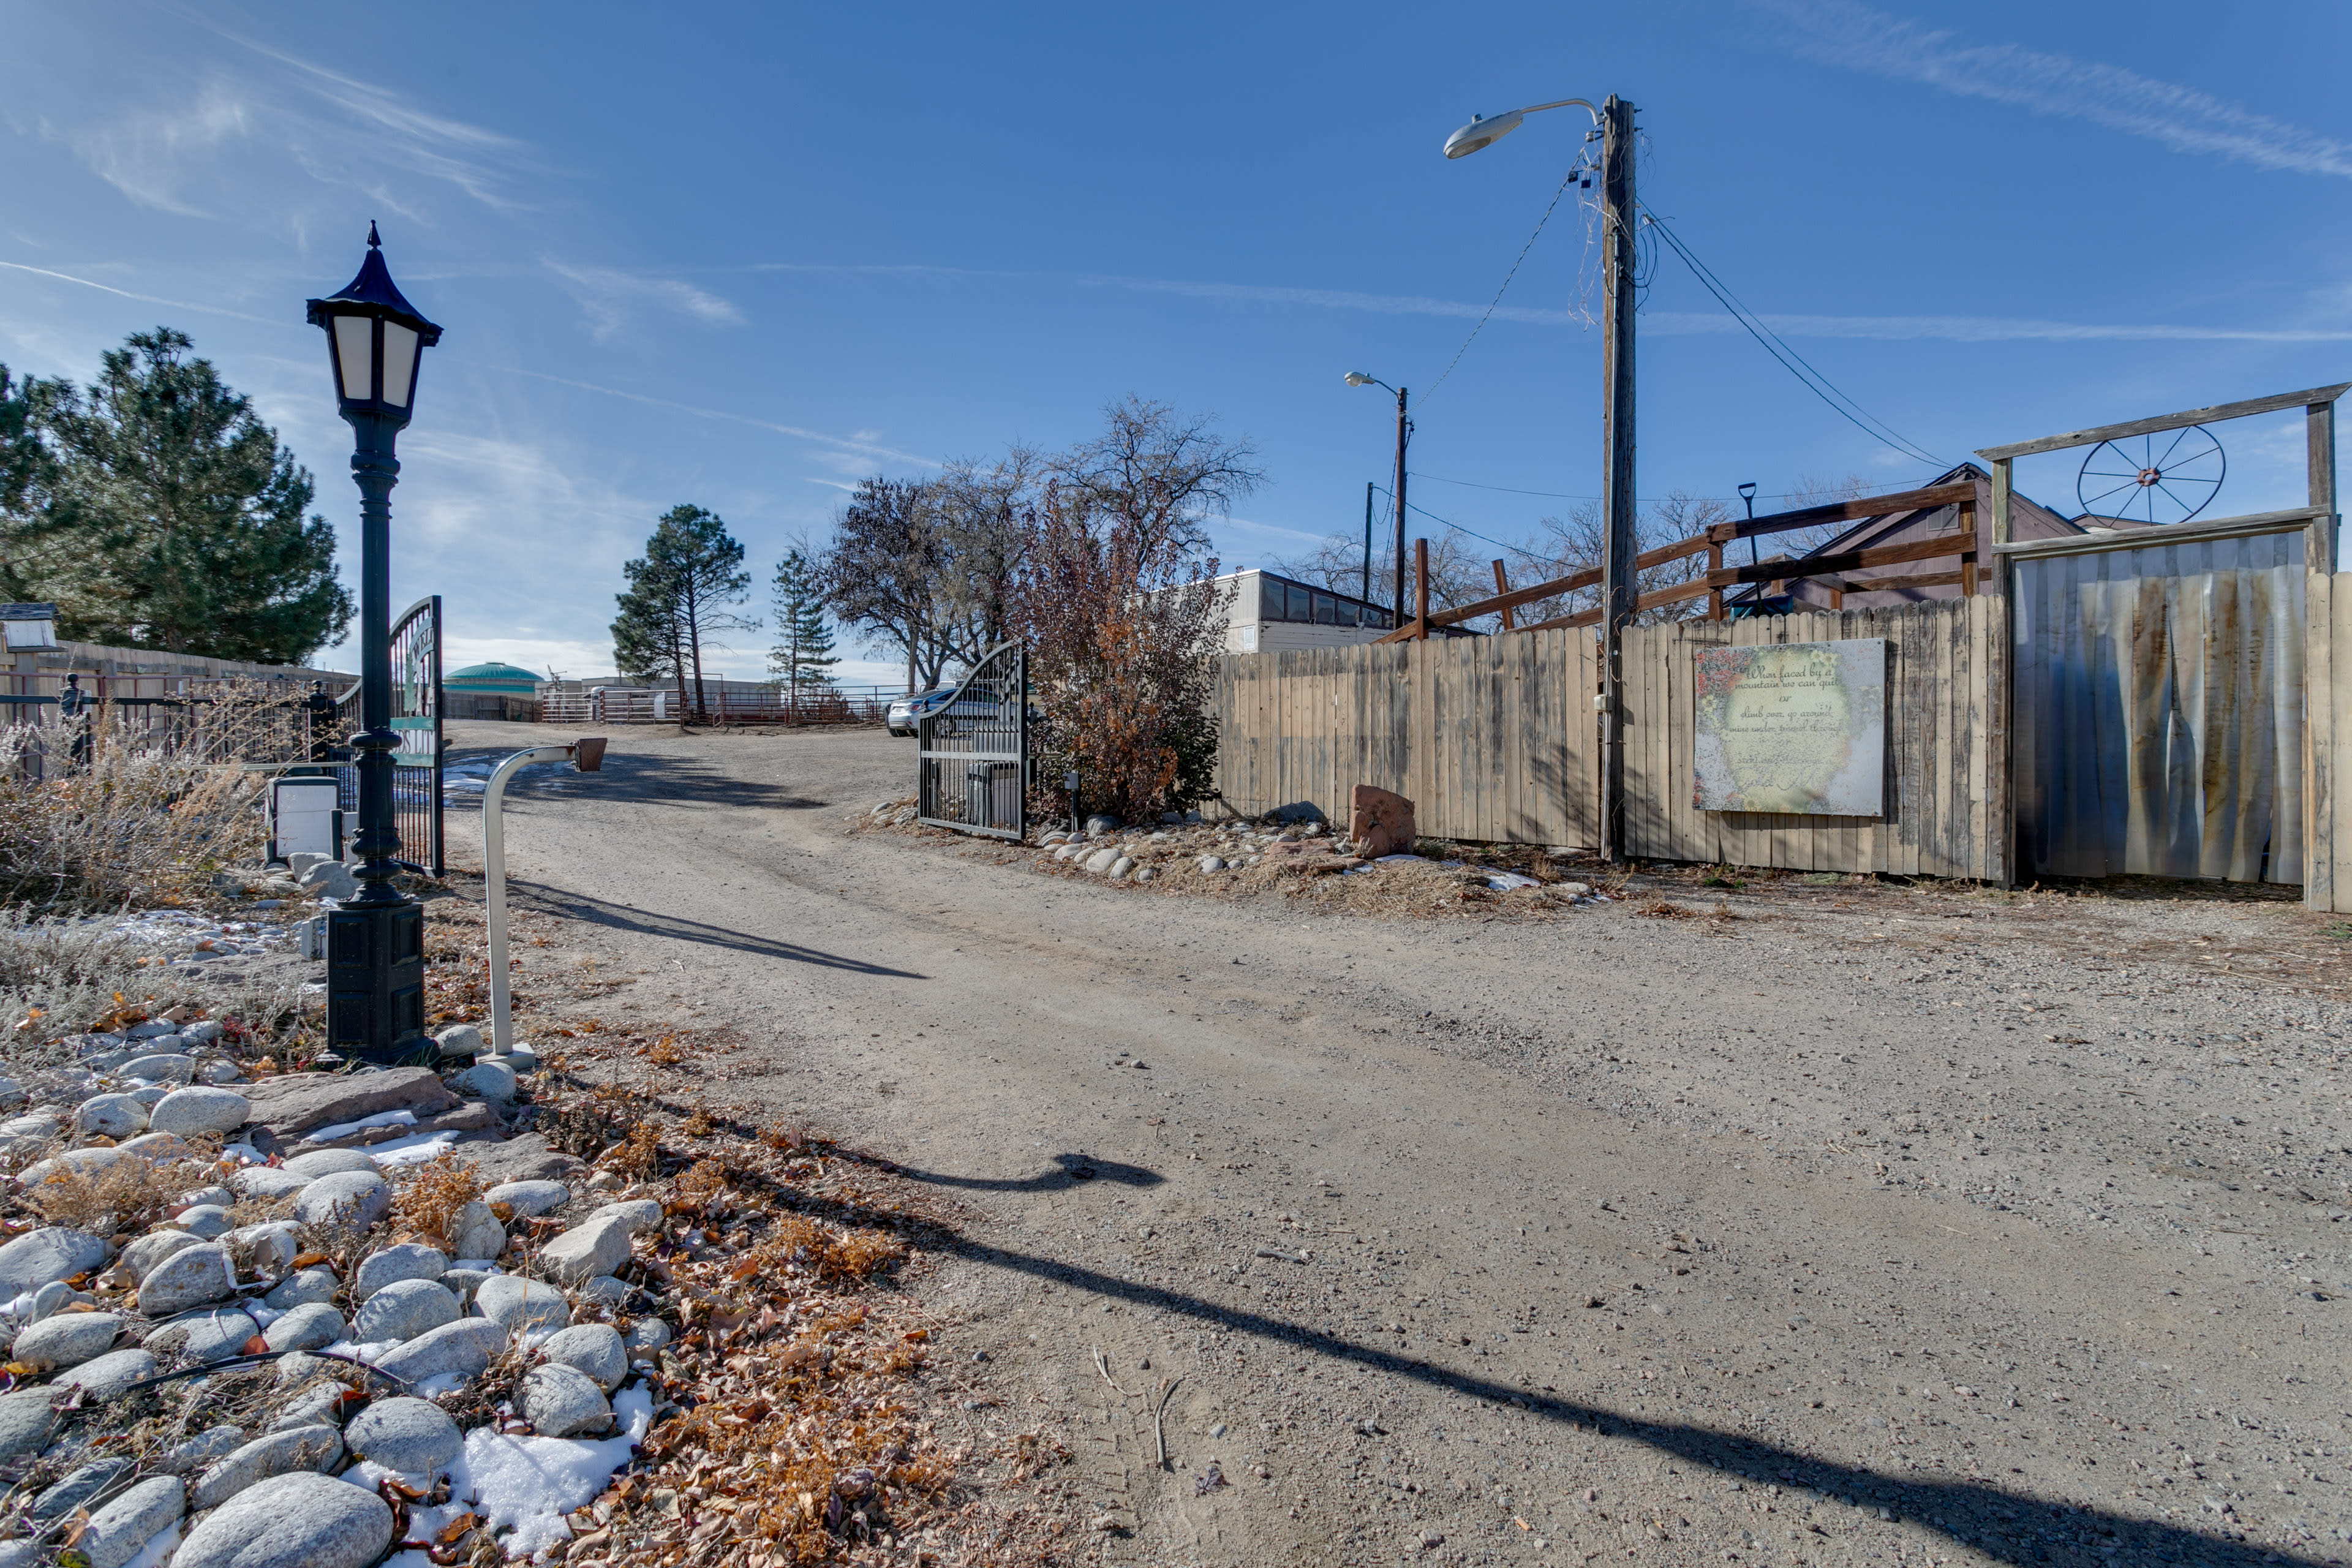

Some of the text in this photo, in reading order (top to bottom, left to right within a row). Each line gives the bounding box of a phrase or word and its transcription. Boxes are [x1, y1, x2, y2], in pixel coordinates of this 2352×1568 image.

[1746, 665, 1776, 680] When
[1779, 665, 1806, 682] faced
[1809, 662, 1822, 681] by
[1735, 680, 1779, 690] mountain
[1819, 677, 1838, 691] quit
[1787, 712, 1798, 721] go
